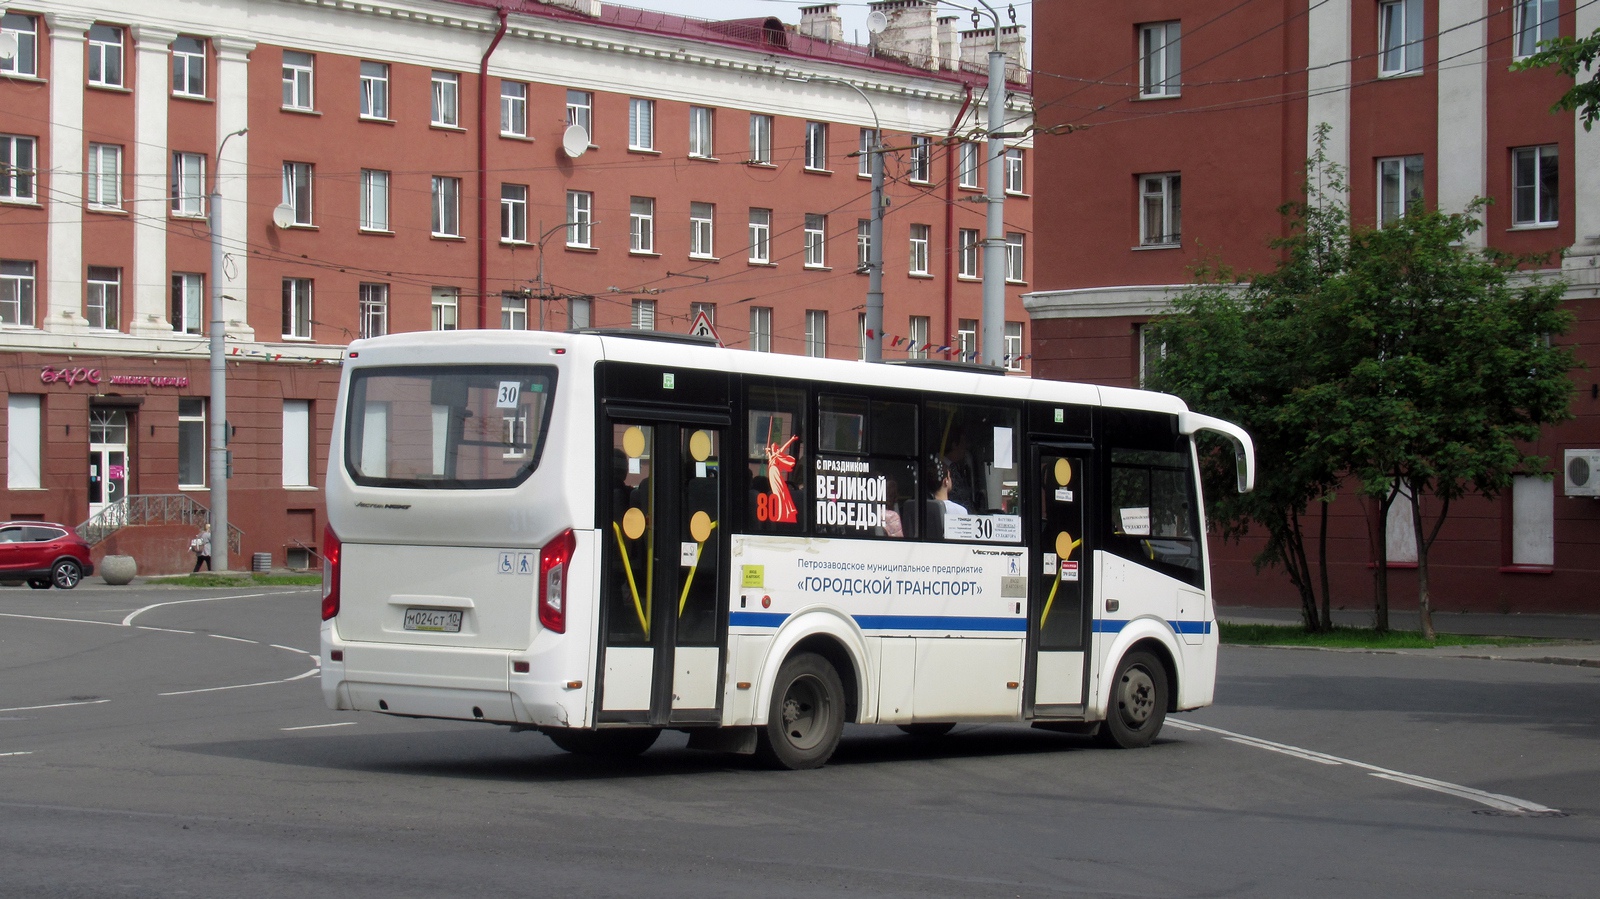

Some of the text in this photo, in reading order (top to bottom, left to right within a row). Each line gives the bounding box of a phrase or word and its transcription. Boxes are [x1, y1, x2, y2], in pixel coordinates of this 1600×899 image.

[499, 386, 517, 403] 30
[816, 460, 870, 473] С ПРАЗДНИКОМ
[816, 475, 887, 502] ВЕЛИКОЙ
[756, 493, 781, 522] 80
[816, 501, 887, 530] ПОБЕДЫ!
[975, 518, 993, 540] 30
[797, 558, 983, 576] Петрозаводское муниципальное предприятие
[797, 577, 983, 596] «ГОРОДСКОЙ ТРАНСПОРТ»
